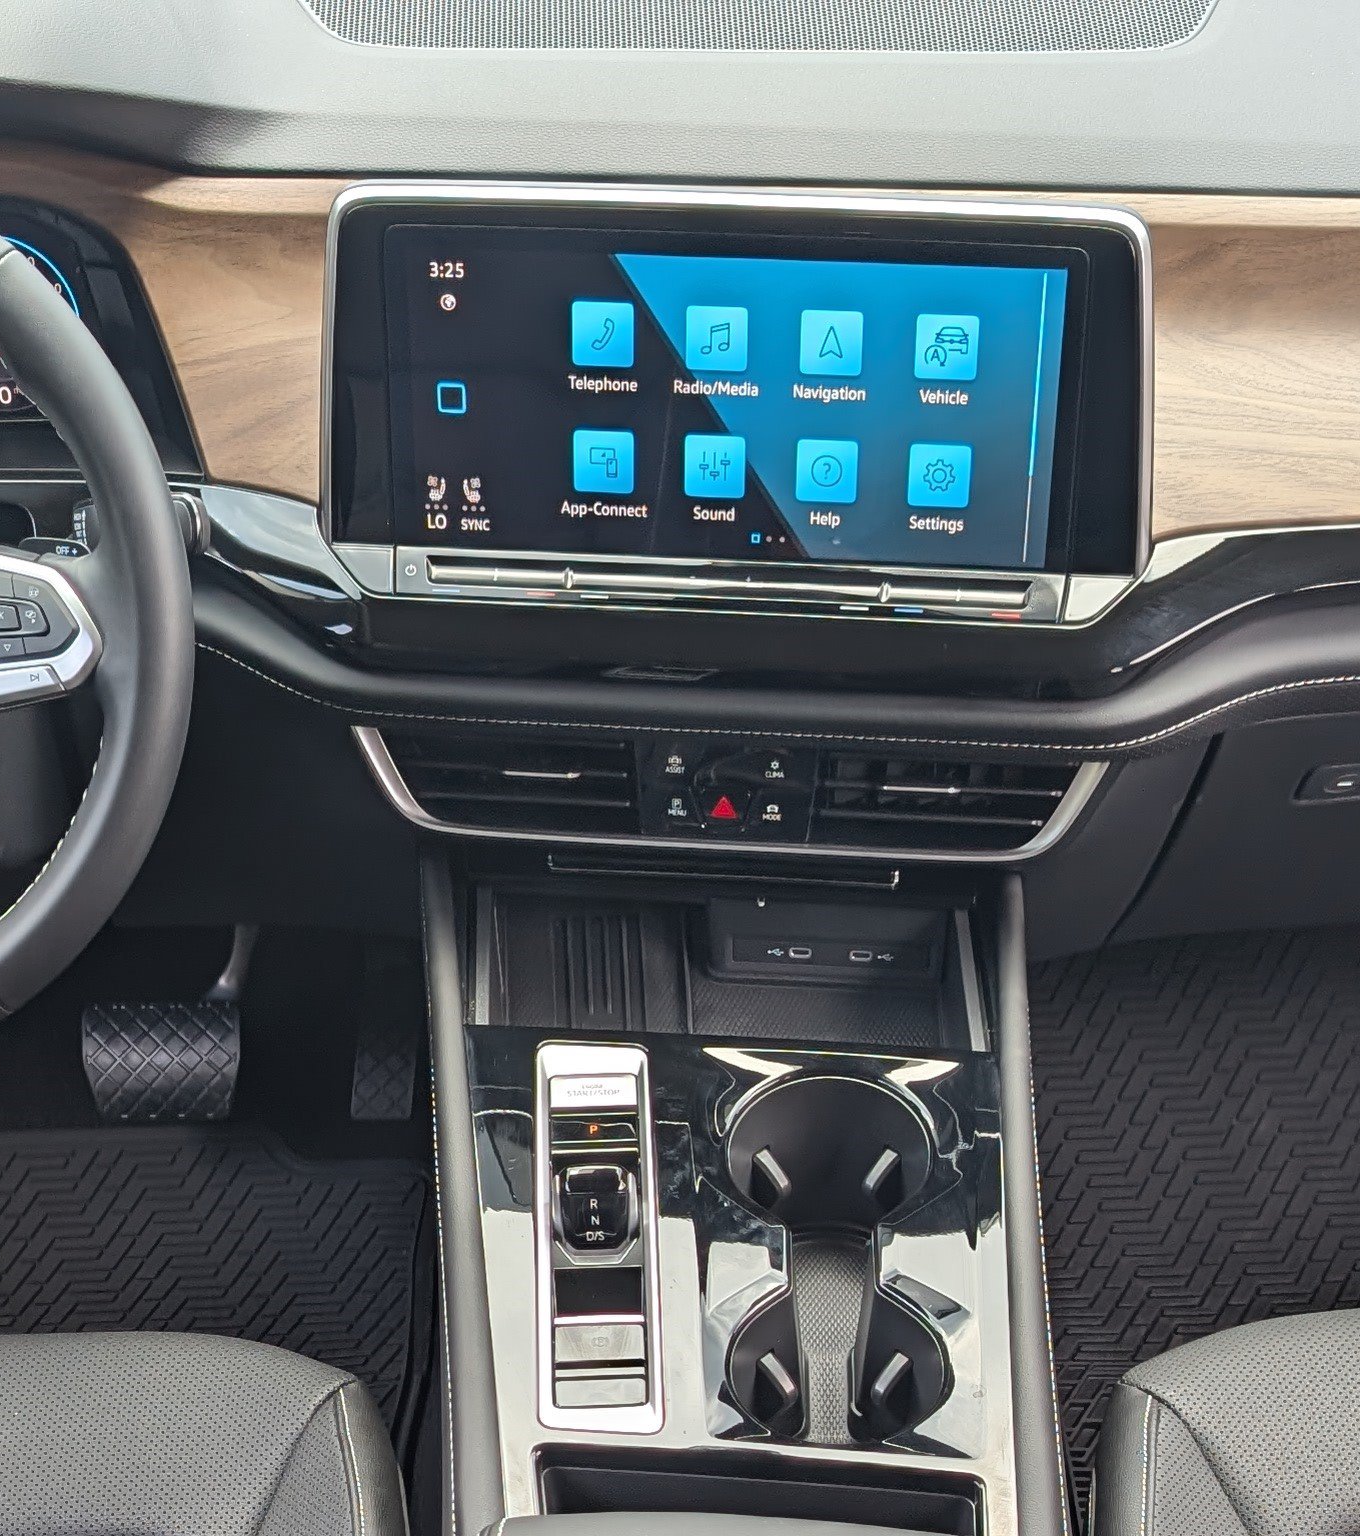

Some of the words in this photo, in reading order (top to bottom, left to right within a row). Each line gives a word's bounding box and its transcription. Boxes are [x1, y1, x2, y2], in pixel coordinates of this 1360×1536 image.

[429, 261, 465, 279] 3:25
[568, 375, 638, 393] Telephone
[673, 379, 759, 397] Radio/Media
[793, 383, 867, 403] Navigation
[919, 388, 969, 405] Vehicle
[561, 500, 648, 519] App-Connect
[693, 505, 736, 522] Sound
[426, 513, 447, 529] LO
[461, 517, 491, 531] SYNC
[810, 511, 841, 528] Help
[909, 515, 965, 534] Settings
[55, 545, 70, 556] OFF
[665, 766, 685, 774] ASSIST
[765, 770, 785, 778] CLIMA
[762, 813, 781, 821] MODE
[589, 1125, 598, 1134] P
[589, 1199, 598, 1210] R
[591, 1215, 601, 1226] N
[586, 1231, 605, 1241] D/S
